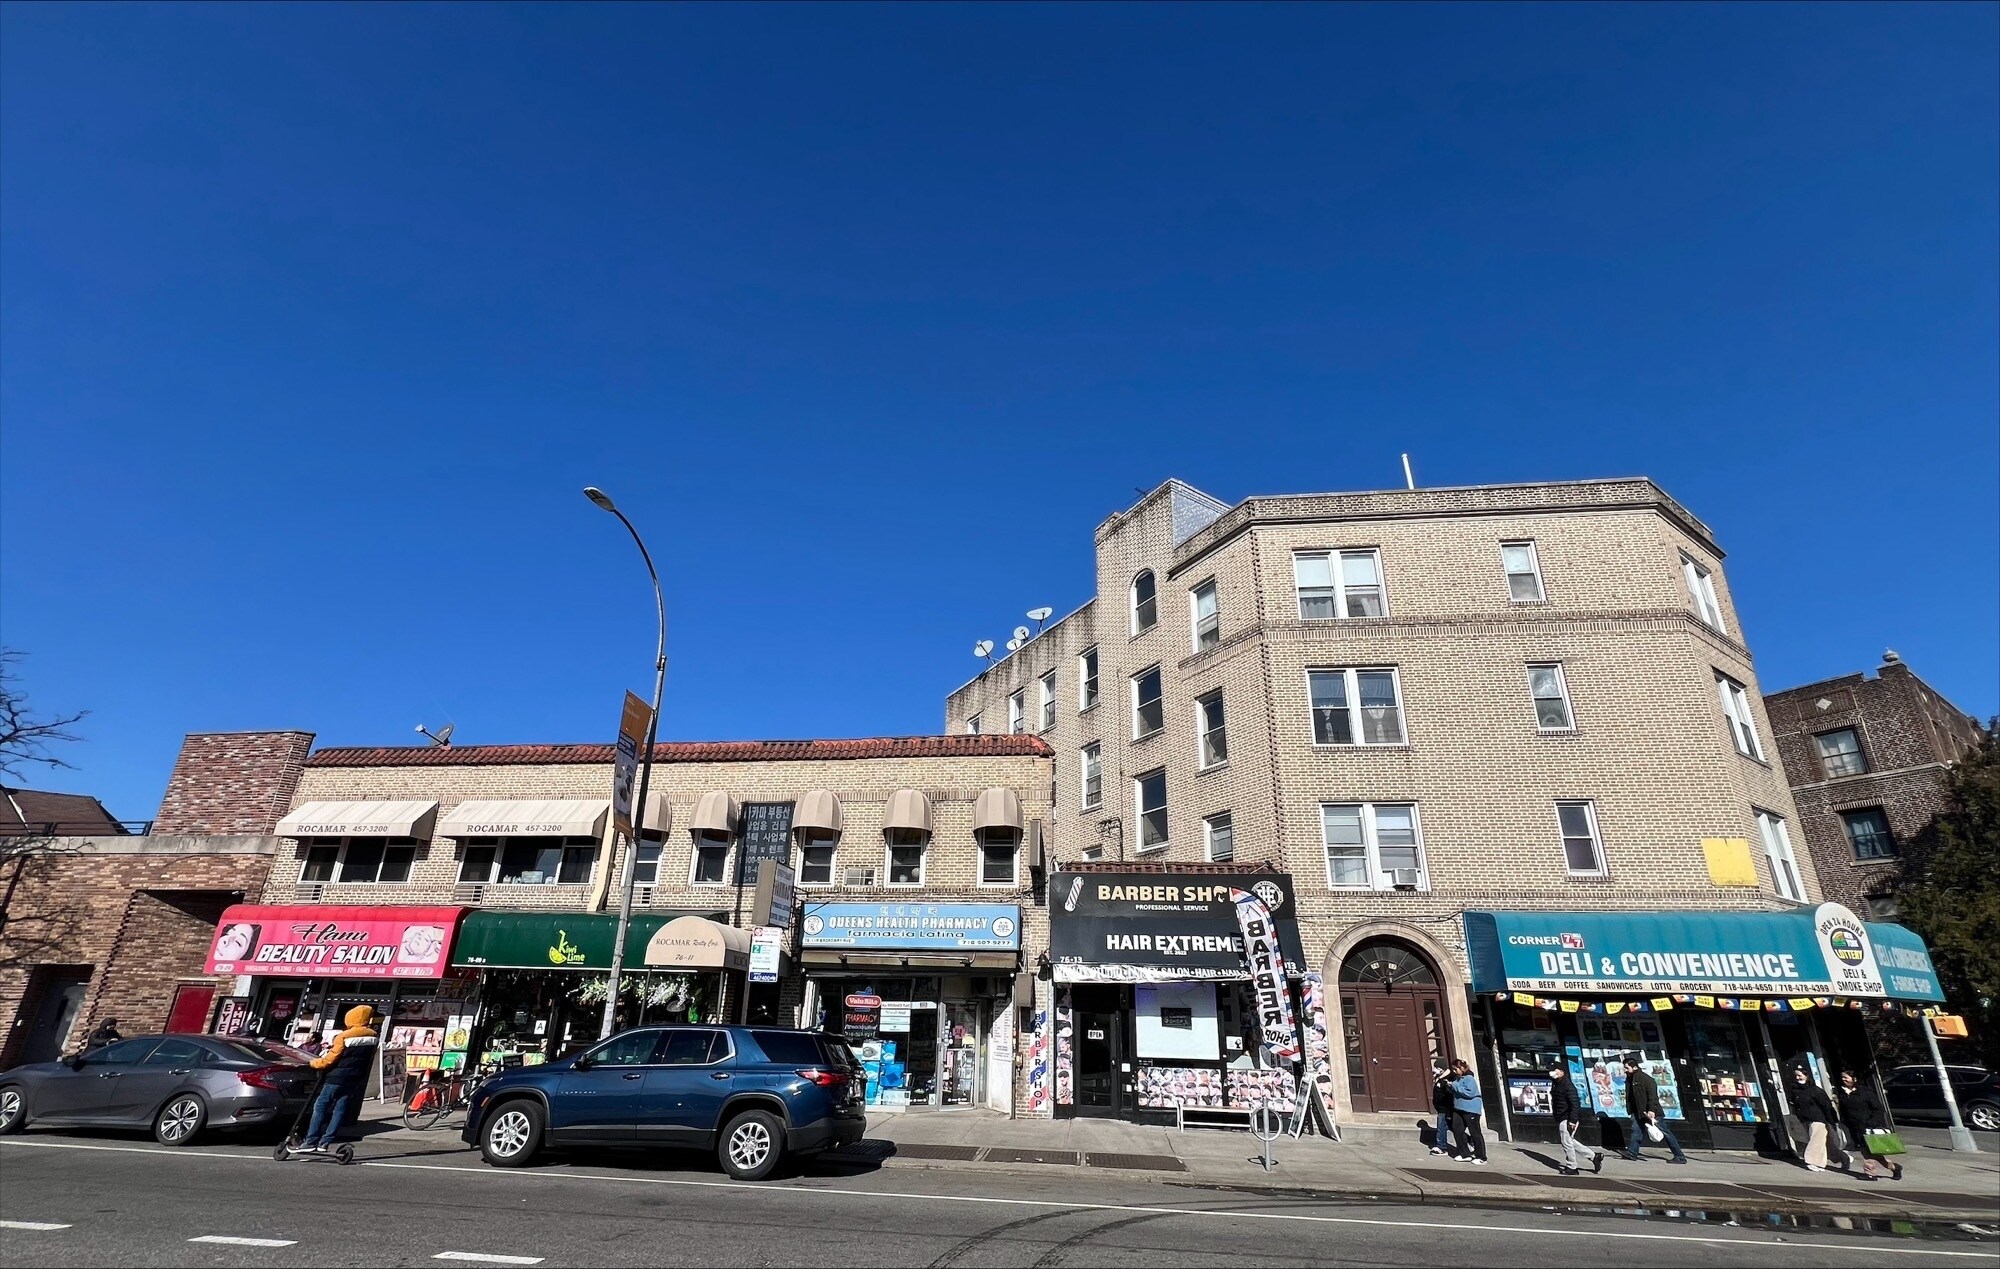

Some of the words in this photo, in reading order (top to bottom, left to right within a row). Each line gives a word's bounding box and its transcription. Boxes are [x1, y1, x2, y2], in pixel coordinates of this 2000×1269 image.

[768, 806, 790, 819] 부동산
[297, 825, 346, 833] ROCAMAR
[466, 825, 519, 833] ROCAMAR
[1097, 885, 1180, 901] BARBER
[829, 916, 873, 929] QUEENS
[876, 916, 918, 929] HEALTH
[921, 917, 989, 929] PHARMACY
[1820, 920, 1834, 936] OPEN
[1832, 917, 1841, 926] 24
[1842, 918, 1865, 938] HOURS
[1106, 934, 1152, 951] HAIR
[1508, 936, 1561, 946] CORNER
[256, 945, 333, 963] BEAUTY
[331, 945, 397, 964] SALON
[567, 954, 586, 962] Lime
[1540, 952, 1595, 975] DELI
[1601, 957, 1617, 975] &
[1620, 953, 1799, 977] CONVENIENCE
[1194, 967, 1218, 978] HAIR
[1843, 969, 1859, 979] DELI
[1861, 970, 1867, 979] &
[1512, 981, 1532, 989] SODA
[1538, 981, 1556, 989] BEER
[1596, 982, 1643, 990] SANDWICHES
[1680, 983, 1712, 991] GROCERY
[1837, 981, 1863, 992] SMOKE
[1864, 982, 1882, 992] SHOP
[1034, 1074, 1043, 1107] SHOP
